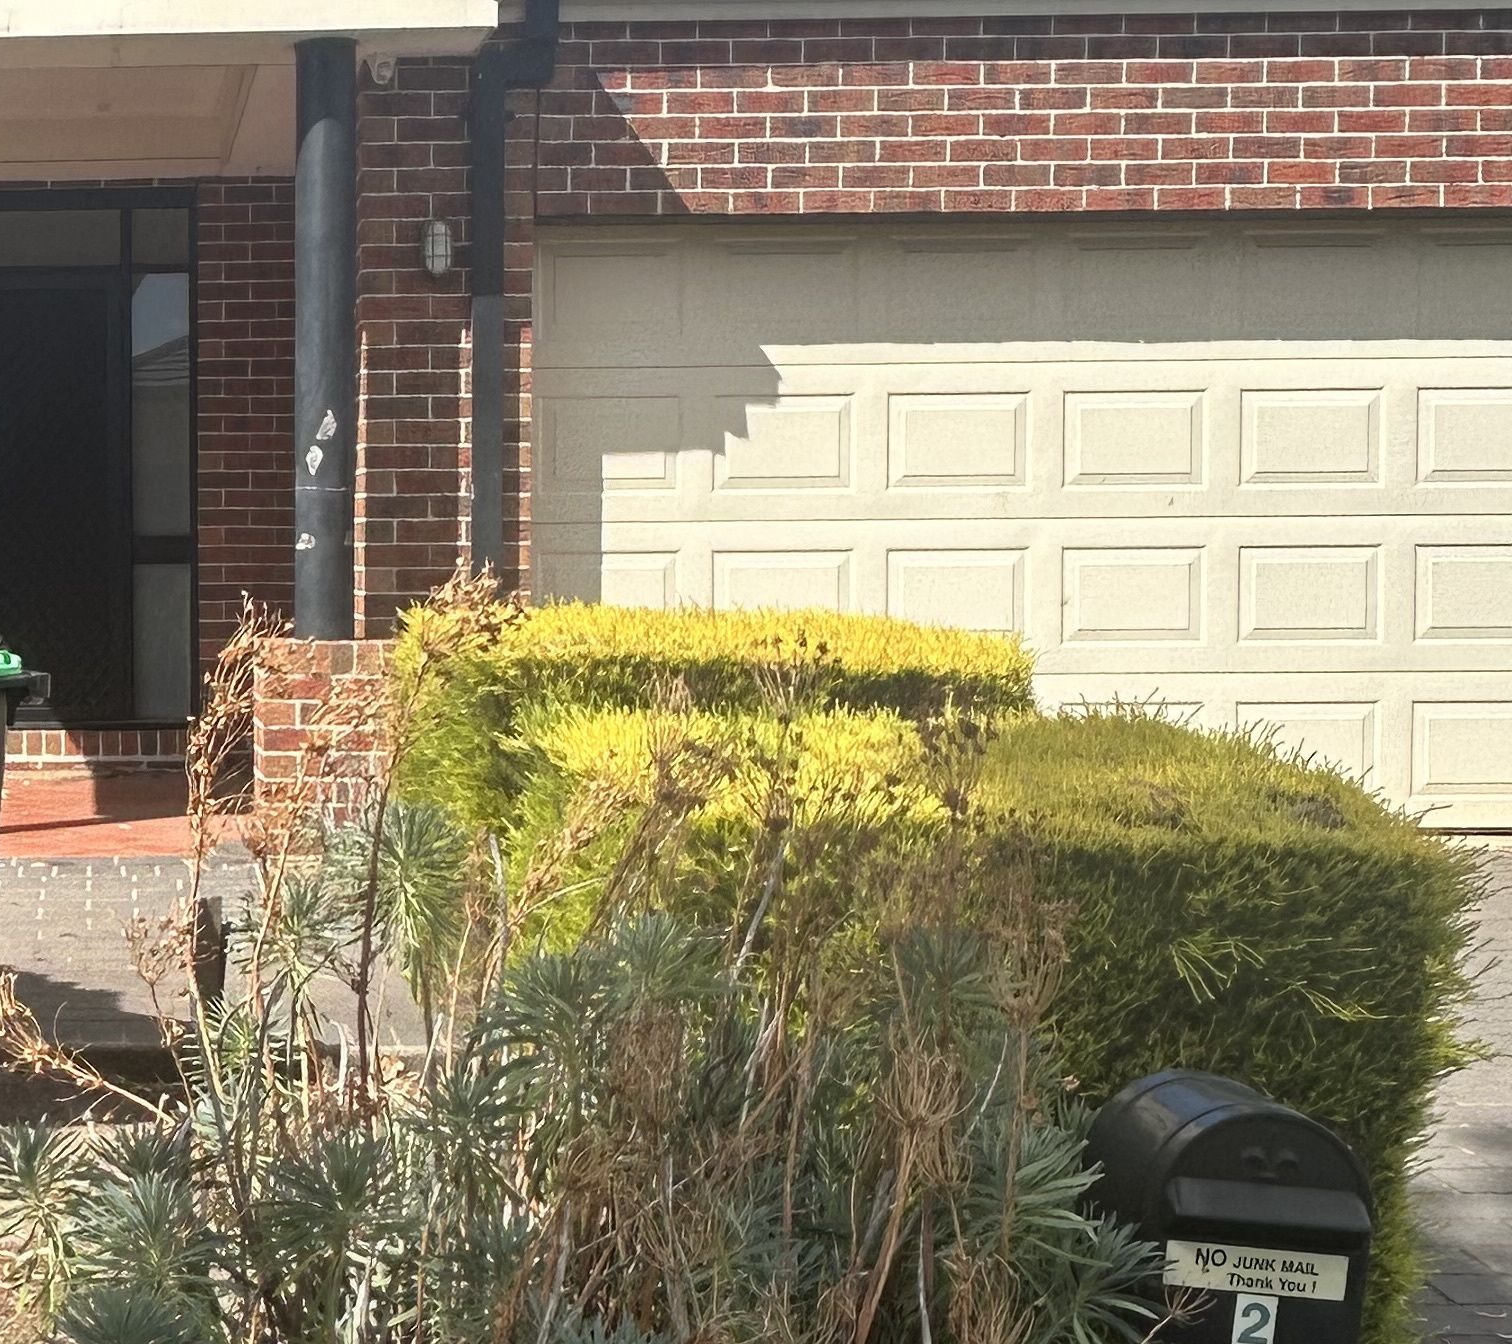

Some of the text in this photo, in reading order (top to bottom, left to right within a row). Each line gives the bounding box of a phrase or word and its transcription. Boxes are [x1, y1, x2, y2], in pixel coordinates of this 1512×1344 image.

[1195, 1247, 1319, 1276] NO JUNK MAIL
[1227, 1272, 1273, 1289] Thank
